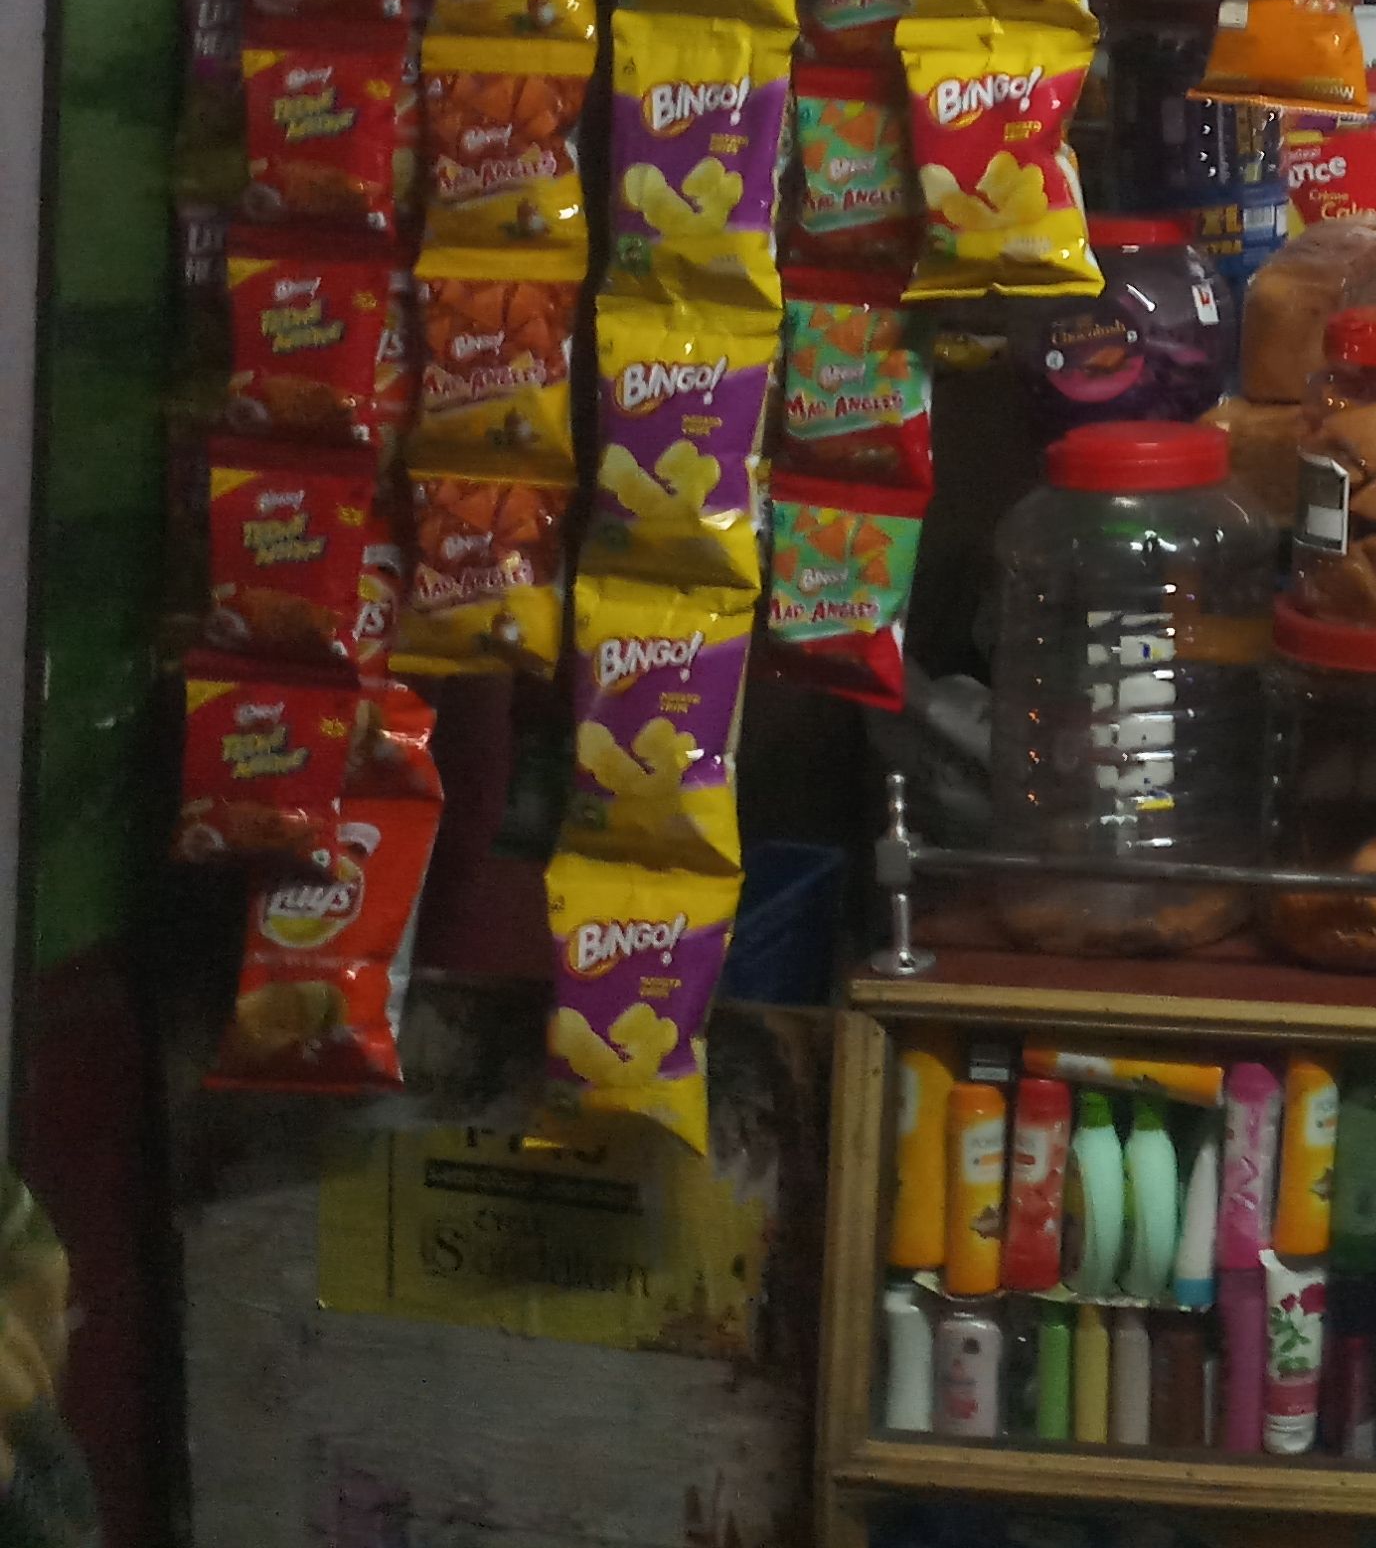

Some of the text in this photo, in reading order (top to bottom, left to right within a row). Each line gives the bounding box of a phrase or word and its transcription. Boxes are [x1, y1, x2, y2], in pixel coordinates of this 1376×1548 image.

[651, 76, 750, 133] BINGO!
[936, 65, 1043, 125] BINGO!
[622, 354, 728, 411] BINGO!
[599, 630, 705, 687] BINGO!
[578, 913, 687, 970] BINGO!
